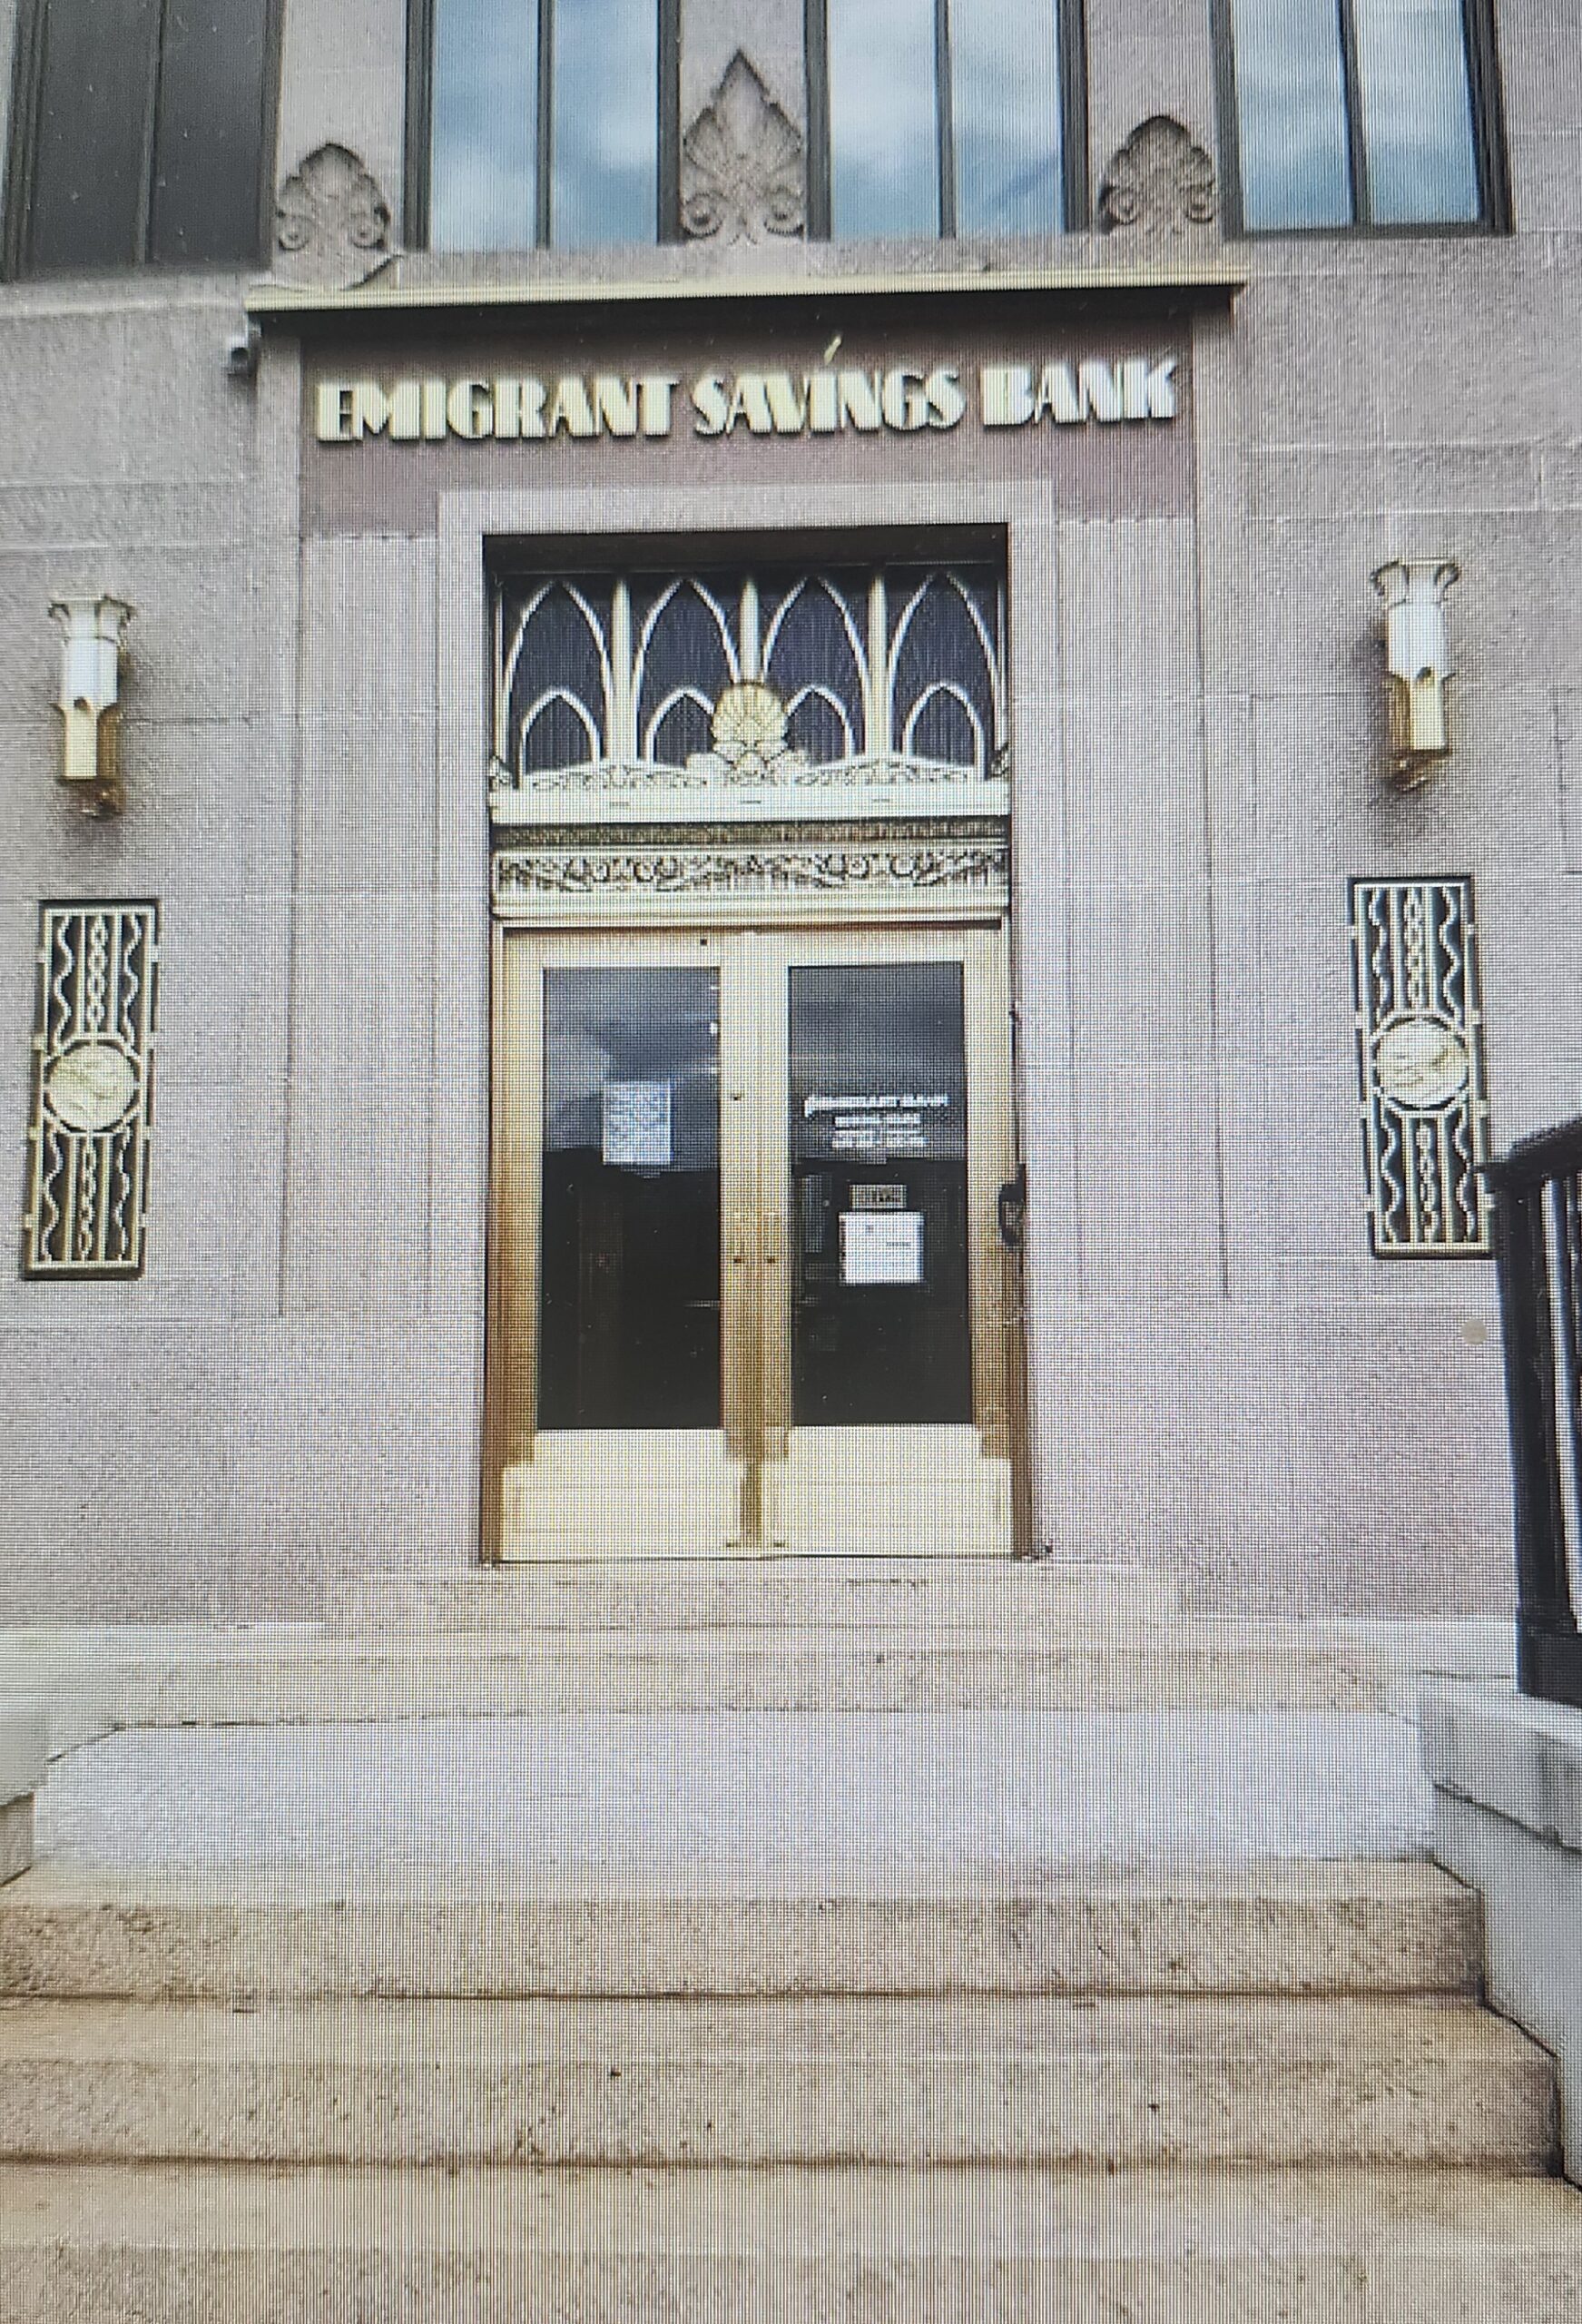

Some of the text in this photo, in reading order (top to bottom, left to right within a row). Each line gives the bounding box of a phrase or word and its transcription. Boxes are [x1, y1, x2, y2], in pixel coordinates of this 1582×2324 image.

[318, 360, 1177, 441] EMIGRANT SAVINGS BANK
